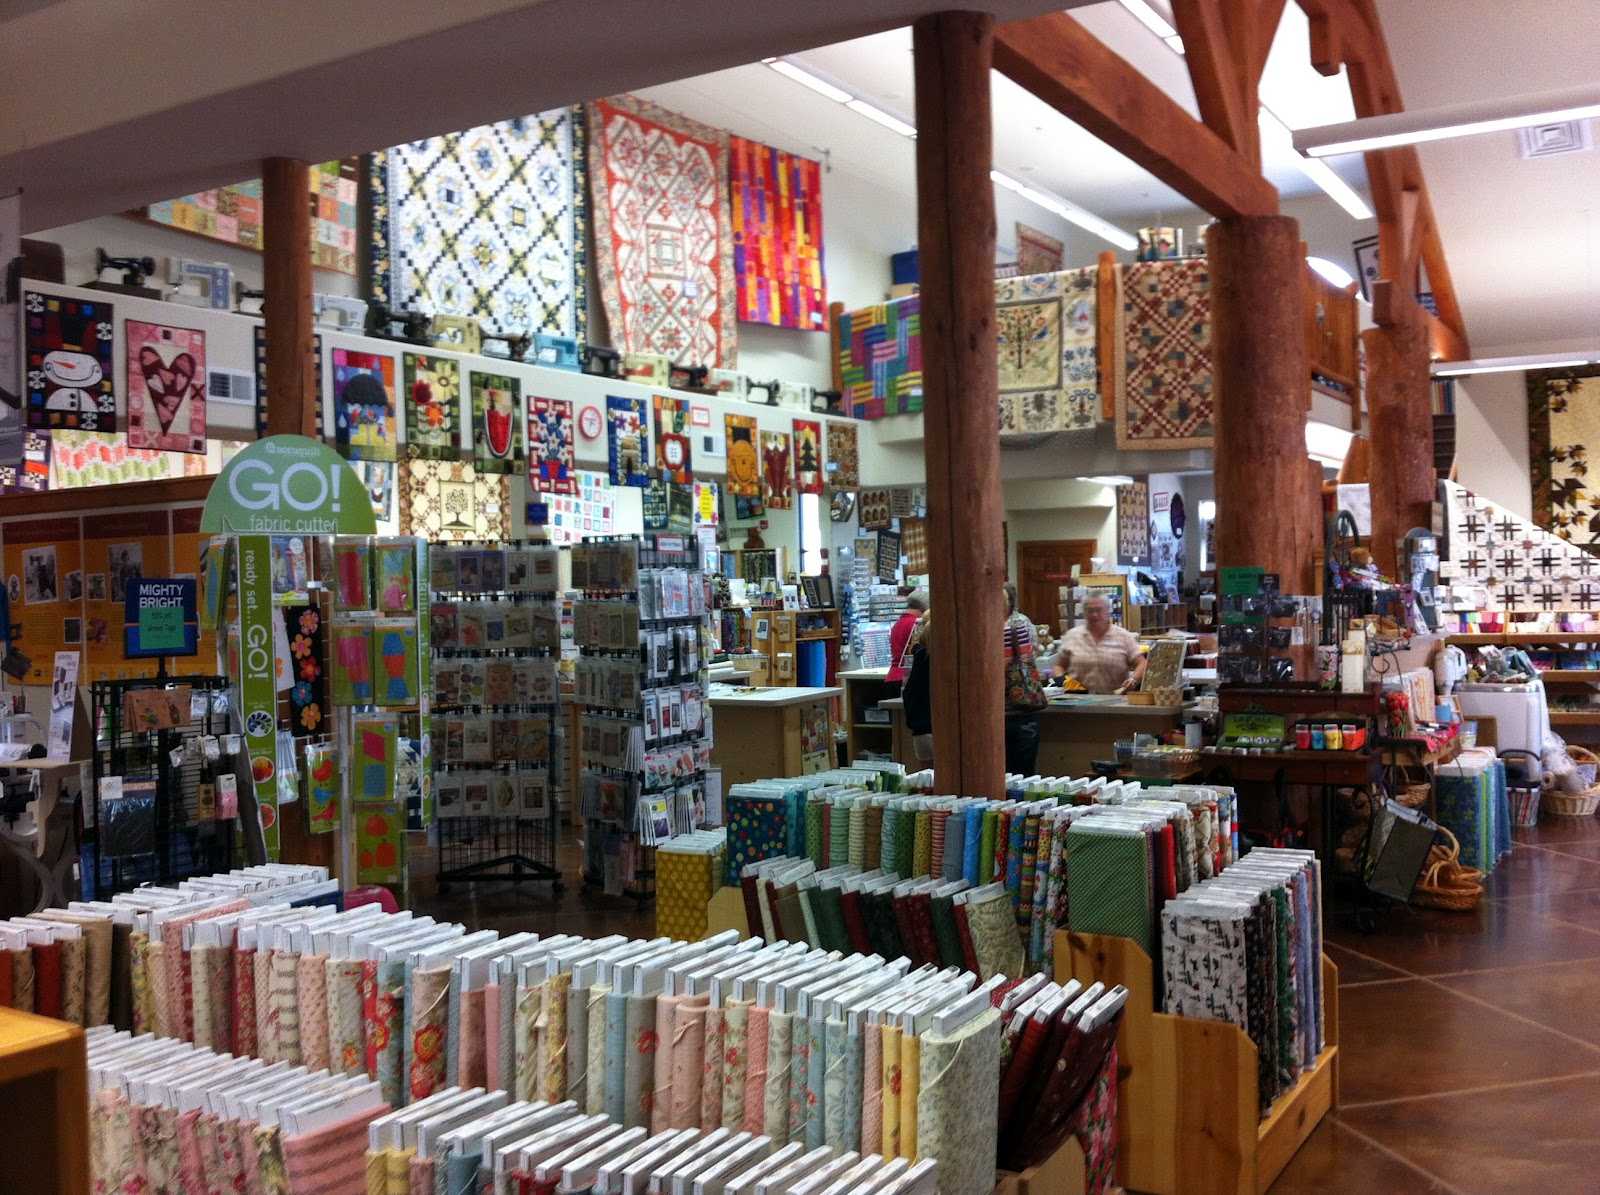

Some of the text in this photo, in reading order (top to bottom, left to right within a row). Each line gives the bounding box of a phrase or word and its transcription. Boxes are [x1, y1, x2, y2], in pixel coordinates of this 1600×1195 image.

[228, 459, 341, 512] GO!
[250, 514, 291, 531] fabric
[244, 550, 258, 585] ready
[139, 584, 184, 596] MIGHTY
[139, 597, 183, 608] BRIGHT
[247, 624, 269, 679] GO!
